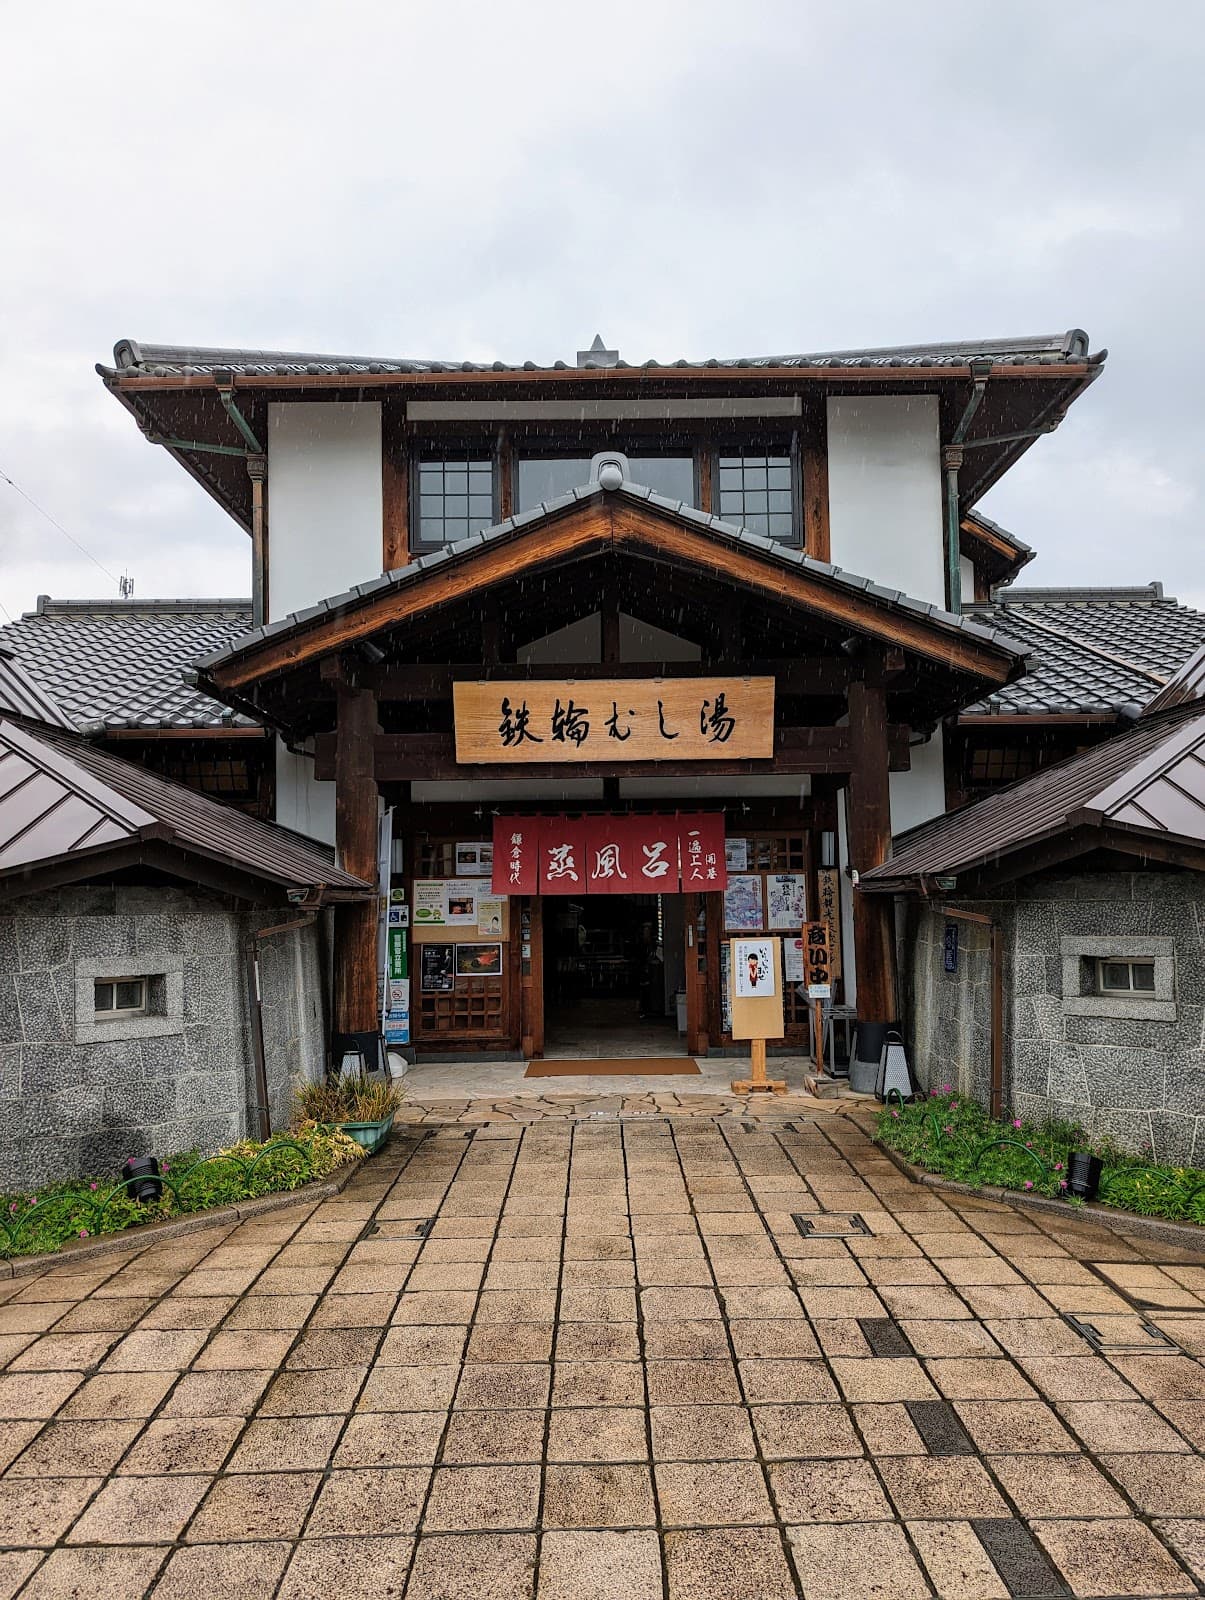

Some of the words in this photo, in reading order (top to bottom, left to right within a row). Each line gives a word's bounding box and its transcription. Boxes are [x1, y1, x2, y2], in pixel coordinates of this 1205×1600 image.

[498, 693, 736, 748] 鉄輪むし湯
[509, 833, 523, 885] 鎌倉時代
[546, 842, 670, 881] 蒸風呂
